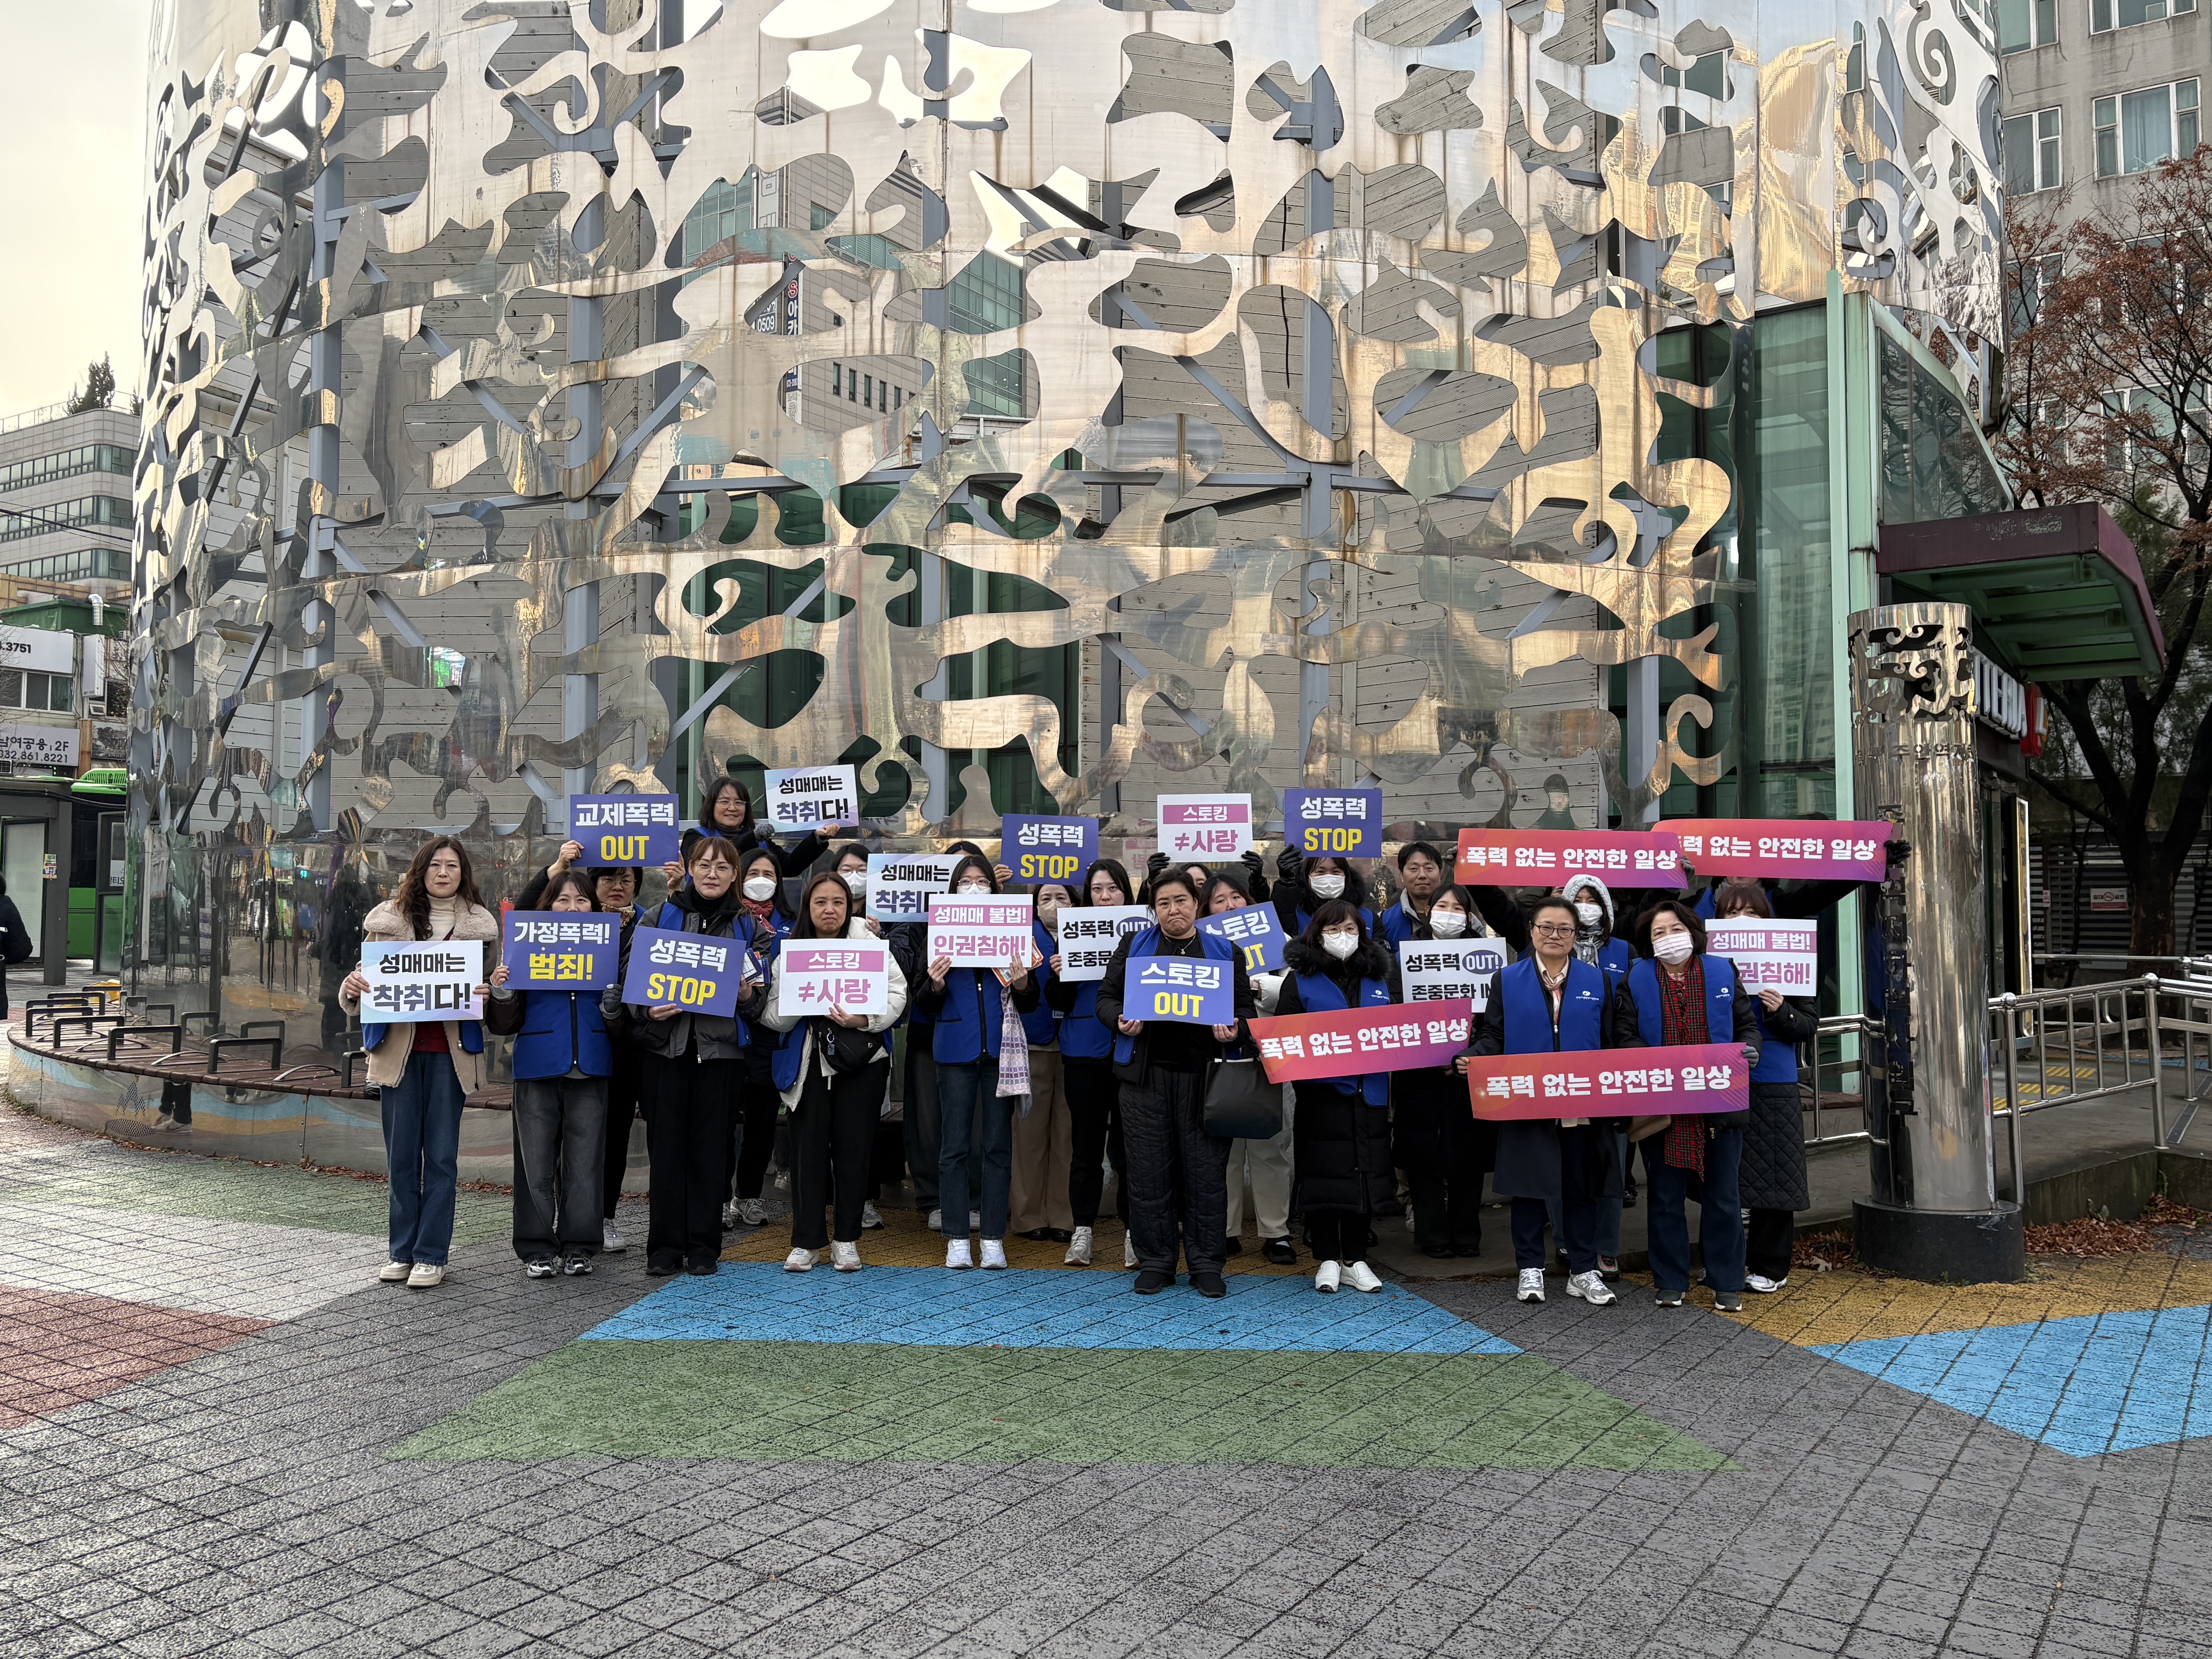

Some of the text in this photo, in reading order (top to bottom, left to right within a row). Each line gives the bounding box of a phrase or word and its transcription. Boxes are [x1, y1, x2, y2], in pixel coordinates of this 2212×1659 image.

[757, 316, 775, 331] 0509
[55, 741, 69, 751] 2F
[779, 776, 843, 794] 성매매는
[575, 803, 673, 826] 교제폭력
[776, 799, 849, 823] 착취다!
[1183, 806, 1228, 821] 스토킹
[1300, 797, 1366, 820] 성폭력
[1018, 823, 1084, 848] 성폭력
[1304, 828, 1362, 851] STOP
[601, 836, 649, 860] OUT
[1466, 847, 1678, 871] 폭력 없는 안전한 일상
[1678, 835, 1876, 860] 력 없는 안전한 일상
[881, 864, 950, 882] 성매매는
[1021, 854, 1078, 879] STOP
[935, 907, 1026, 924] 성매매 불법!
[514, 922, 610, 944] 가정폭력!
[1063, 920, 1114, 938] 성폭력
[934, 935, 1025, 957] 인권침해!
[1712, 933, 1810, 951] 성매매 불법!
[380, 953, 465, 974] 성매매는
[529, 953, 592, 980] 범죄!
[650, 938, 727, 972] 성폭력
[808, 953, 860, 969] 스토킹
[1067, 951, 1114, 968] 존중문
[1406, 954, 1499, 972] 성폭력 OUT!
[1141, 963, 1220, 989] 스토킹
[1738, 962, 1810, 984] 권침해!
[373, 982, 470, 1012] 착취다!
[647, 974, 716, 1005] STOP
[1412, 984, 1476, 1000] 존중문화
[1154, 991, 1204, 1017] OUT
[1261, 1018, 1468, 1060] 폭력 없는 안전한 일상
[1486, 1065, 1732, 1099] 폭력 없는 안전한 일상
